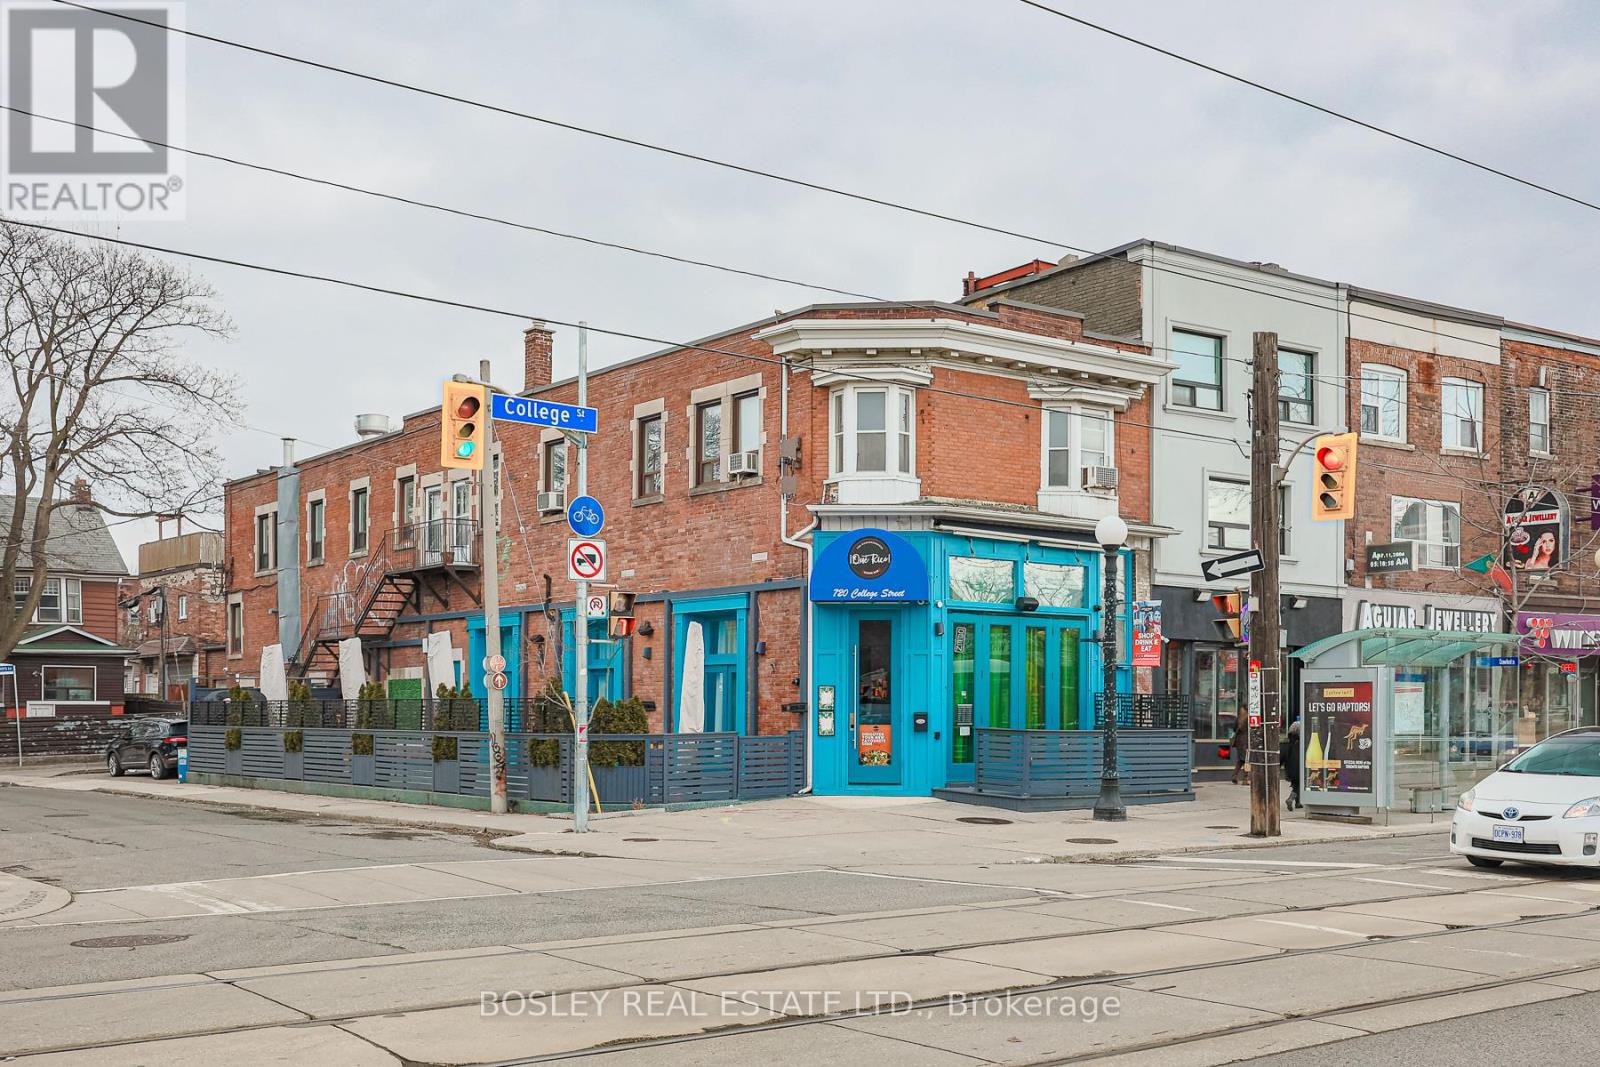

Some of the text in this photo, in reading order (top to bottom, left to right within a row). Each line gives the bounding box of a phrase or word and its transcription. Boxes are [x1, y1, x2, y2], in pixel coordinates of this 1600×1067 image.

[504, 398, 586, 425] College St
[1395, 557, 1409, 566] AM
[832, 588, 905, 599] 720 College Street
[1359, 602, 1498, 633] AGUIAR JEWELLERY
[1308, 702, 1371, 712] LET'S GO RAPTORS!
